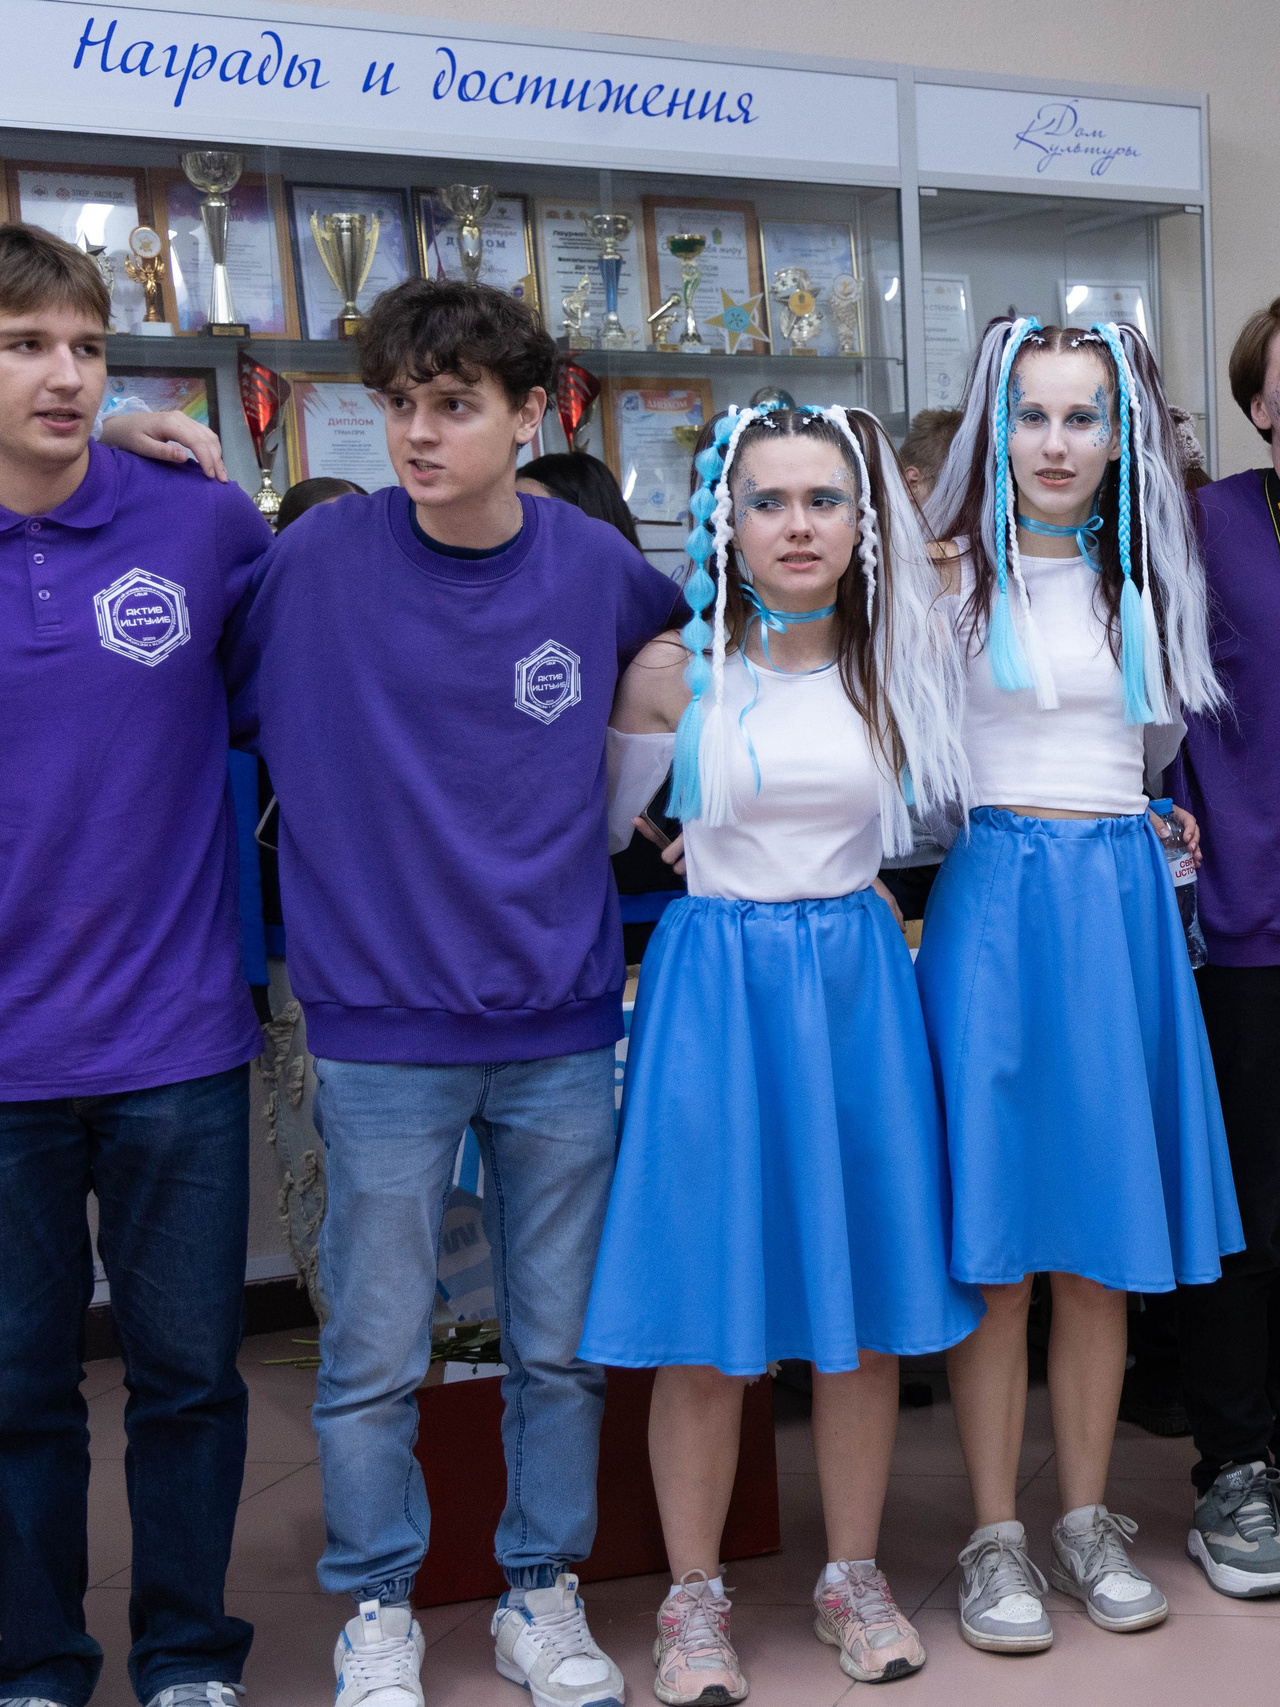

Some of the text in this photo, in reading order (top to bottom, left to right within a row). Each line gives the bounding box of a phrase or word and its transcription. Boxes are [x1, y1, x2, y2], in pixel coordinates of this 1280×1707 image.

[73, 17, 759, 124] Награды и достижения
[1037, 99, 1107, 138] Дом
[1013, 118, 1141, 176] Культуры
[328, 418, 374, 426] ДИПЛОМ
[125, 606, 163, 617] АКТИВ
[537, 673, 563, 683] АКТИВ
